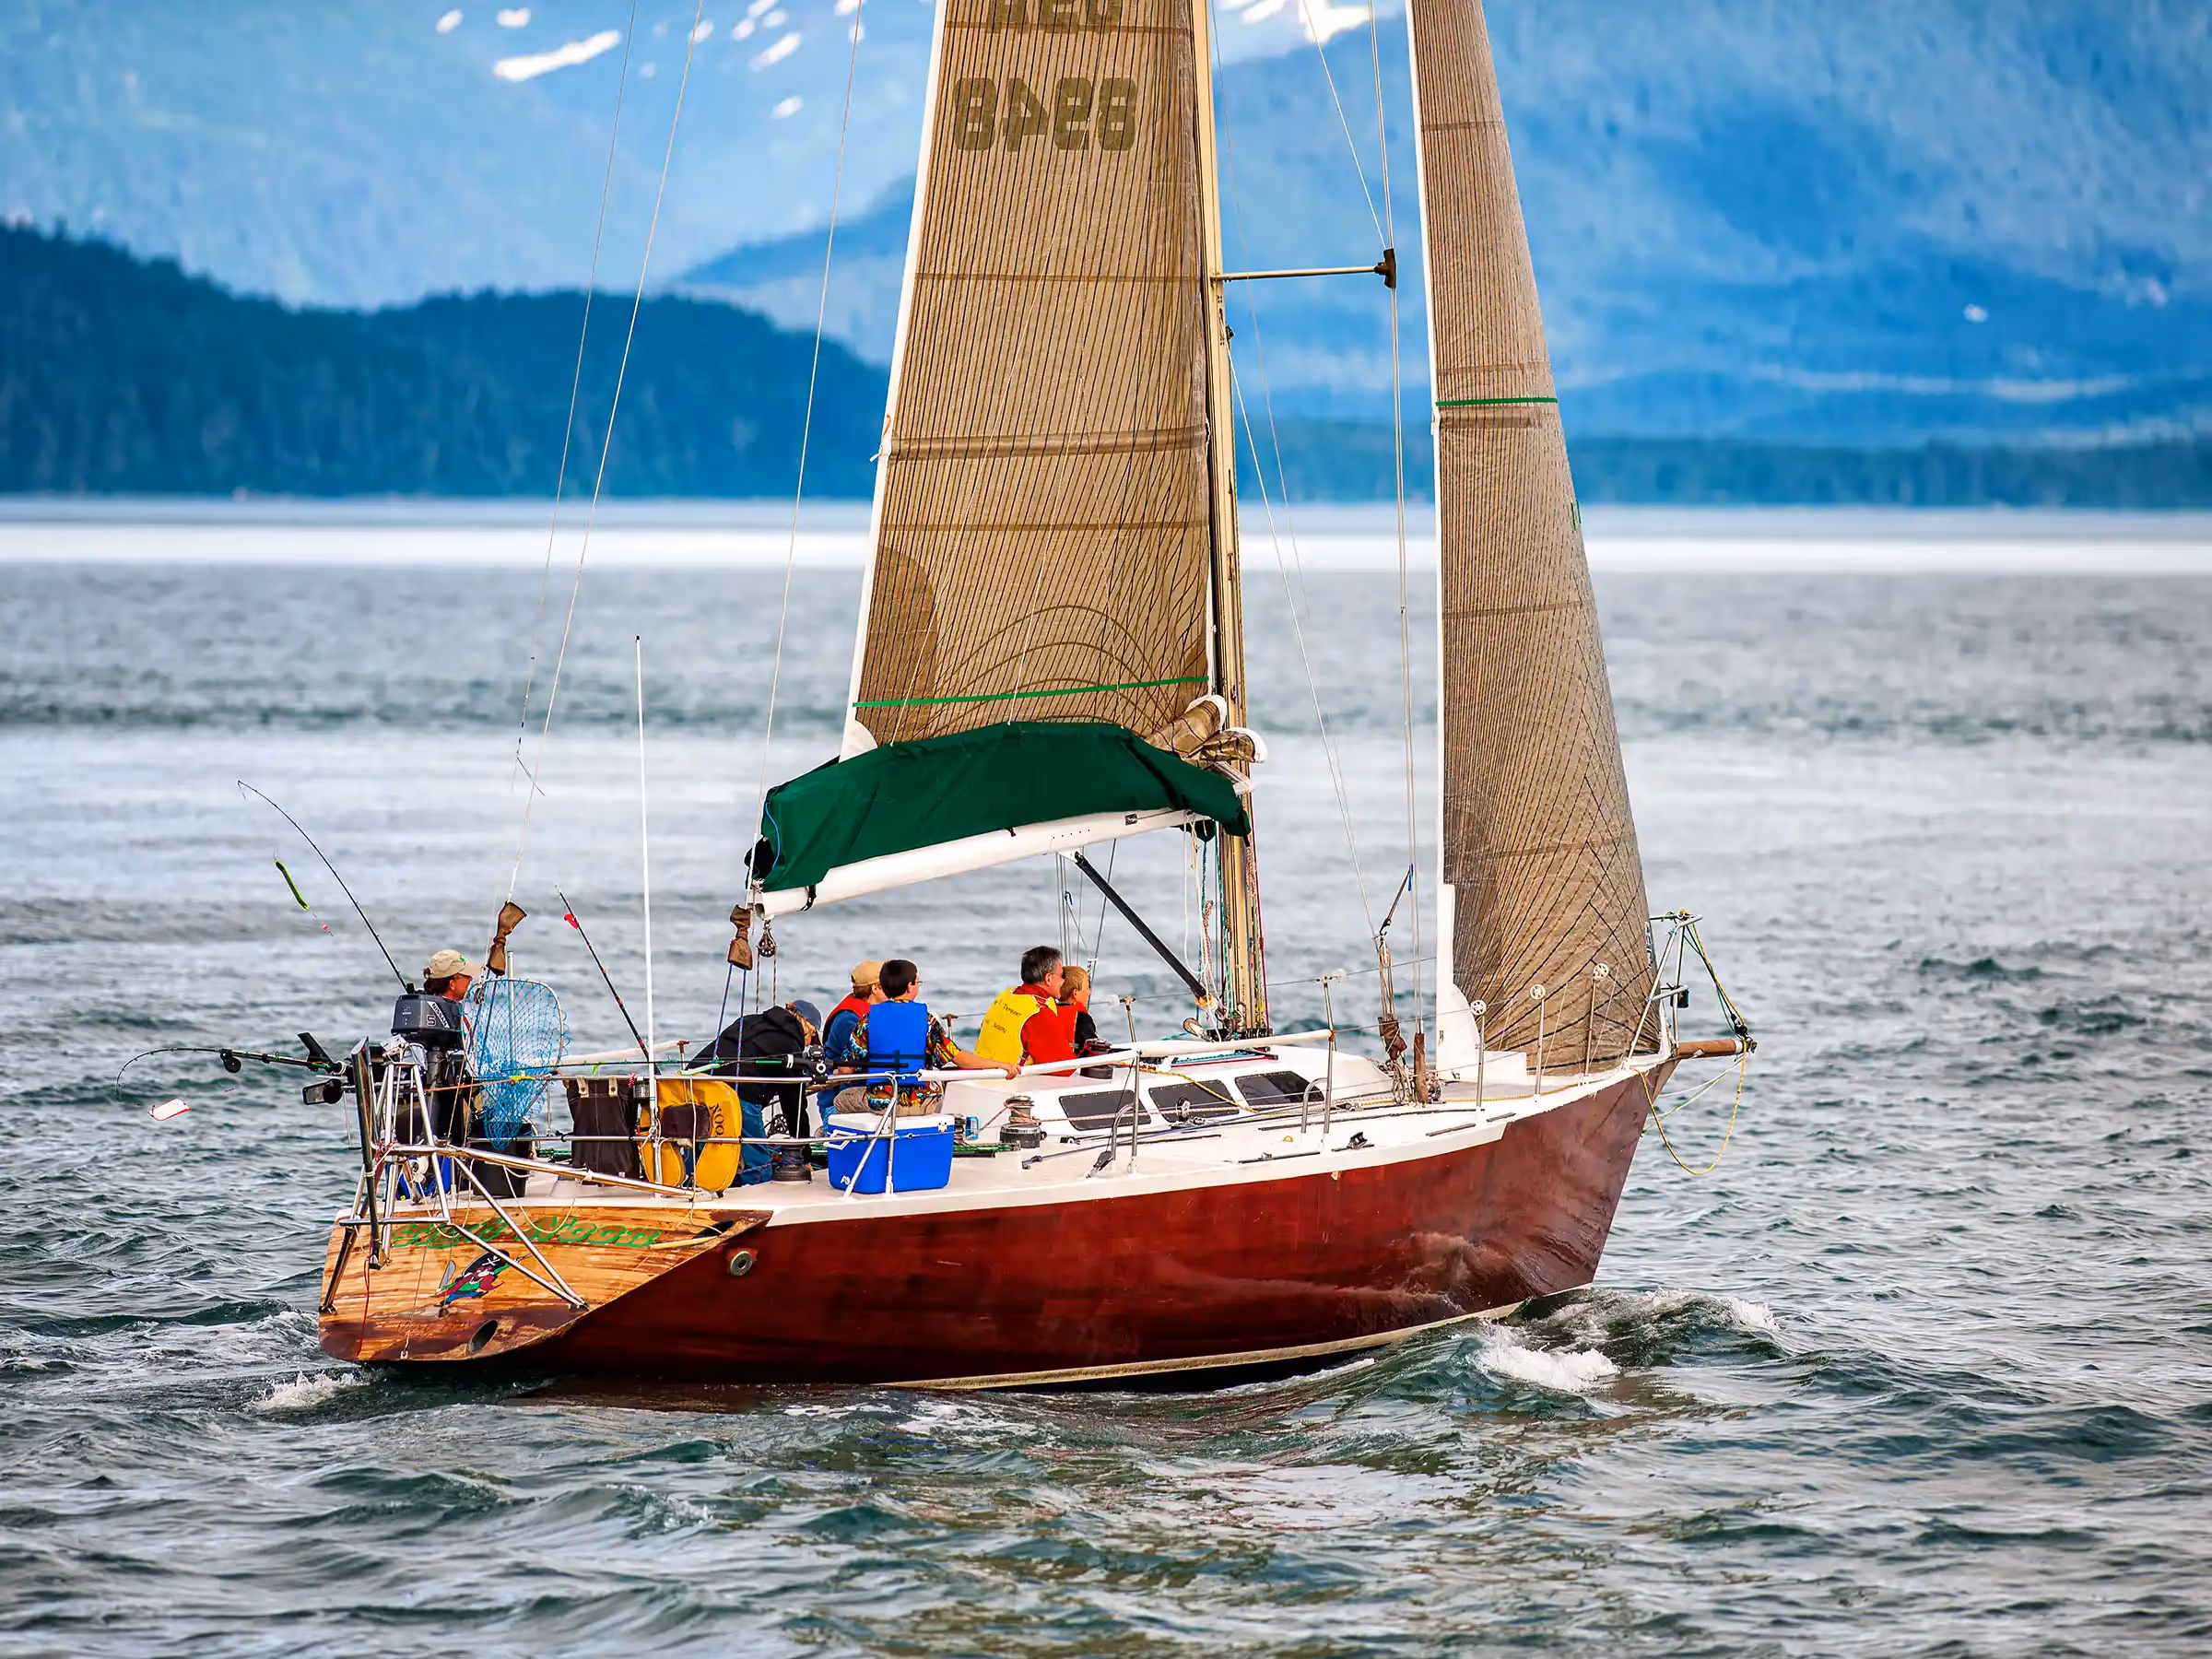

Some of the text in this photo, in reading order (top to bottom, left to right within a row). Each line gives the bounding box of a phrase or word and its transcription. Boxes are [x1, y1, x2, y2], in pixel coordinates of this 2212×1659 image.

[426, 1014, 437, 1027] 5
[431, 1003, 448, 1027] NISSAN
[709, 1102, 725, 1146] NOO
